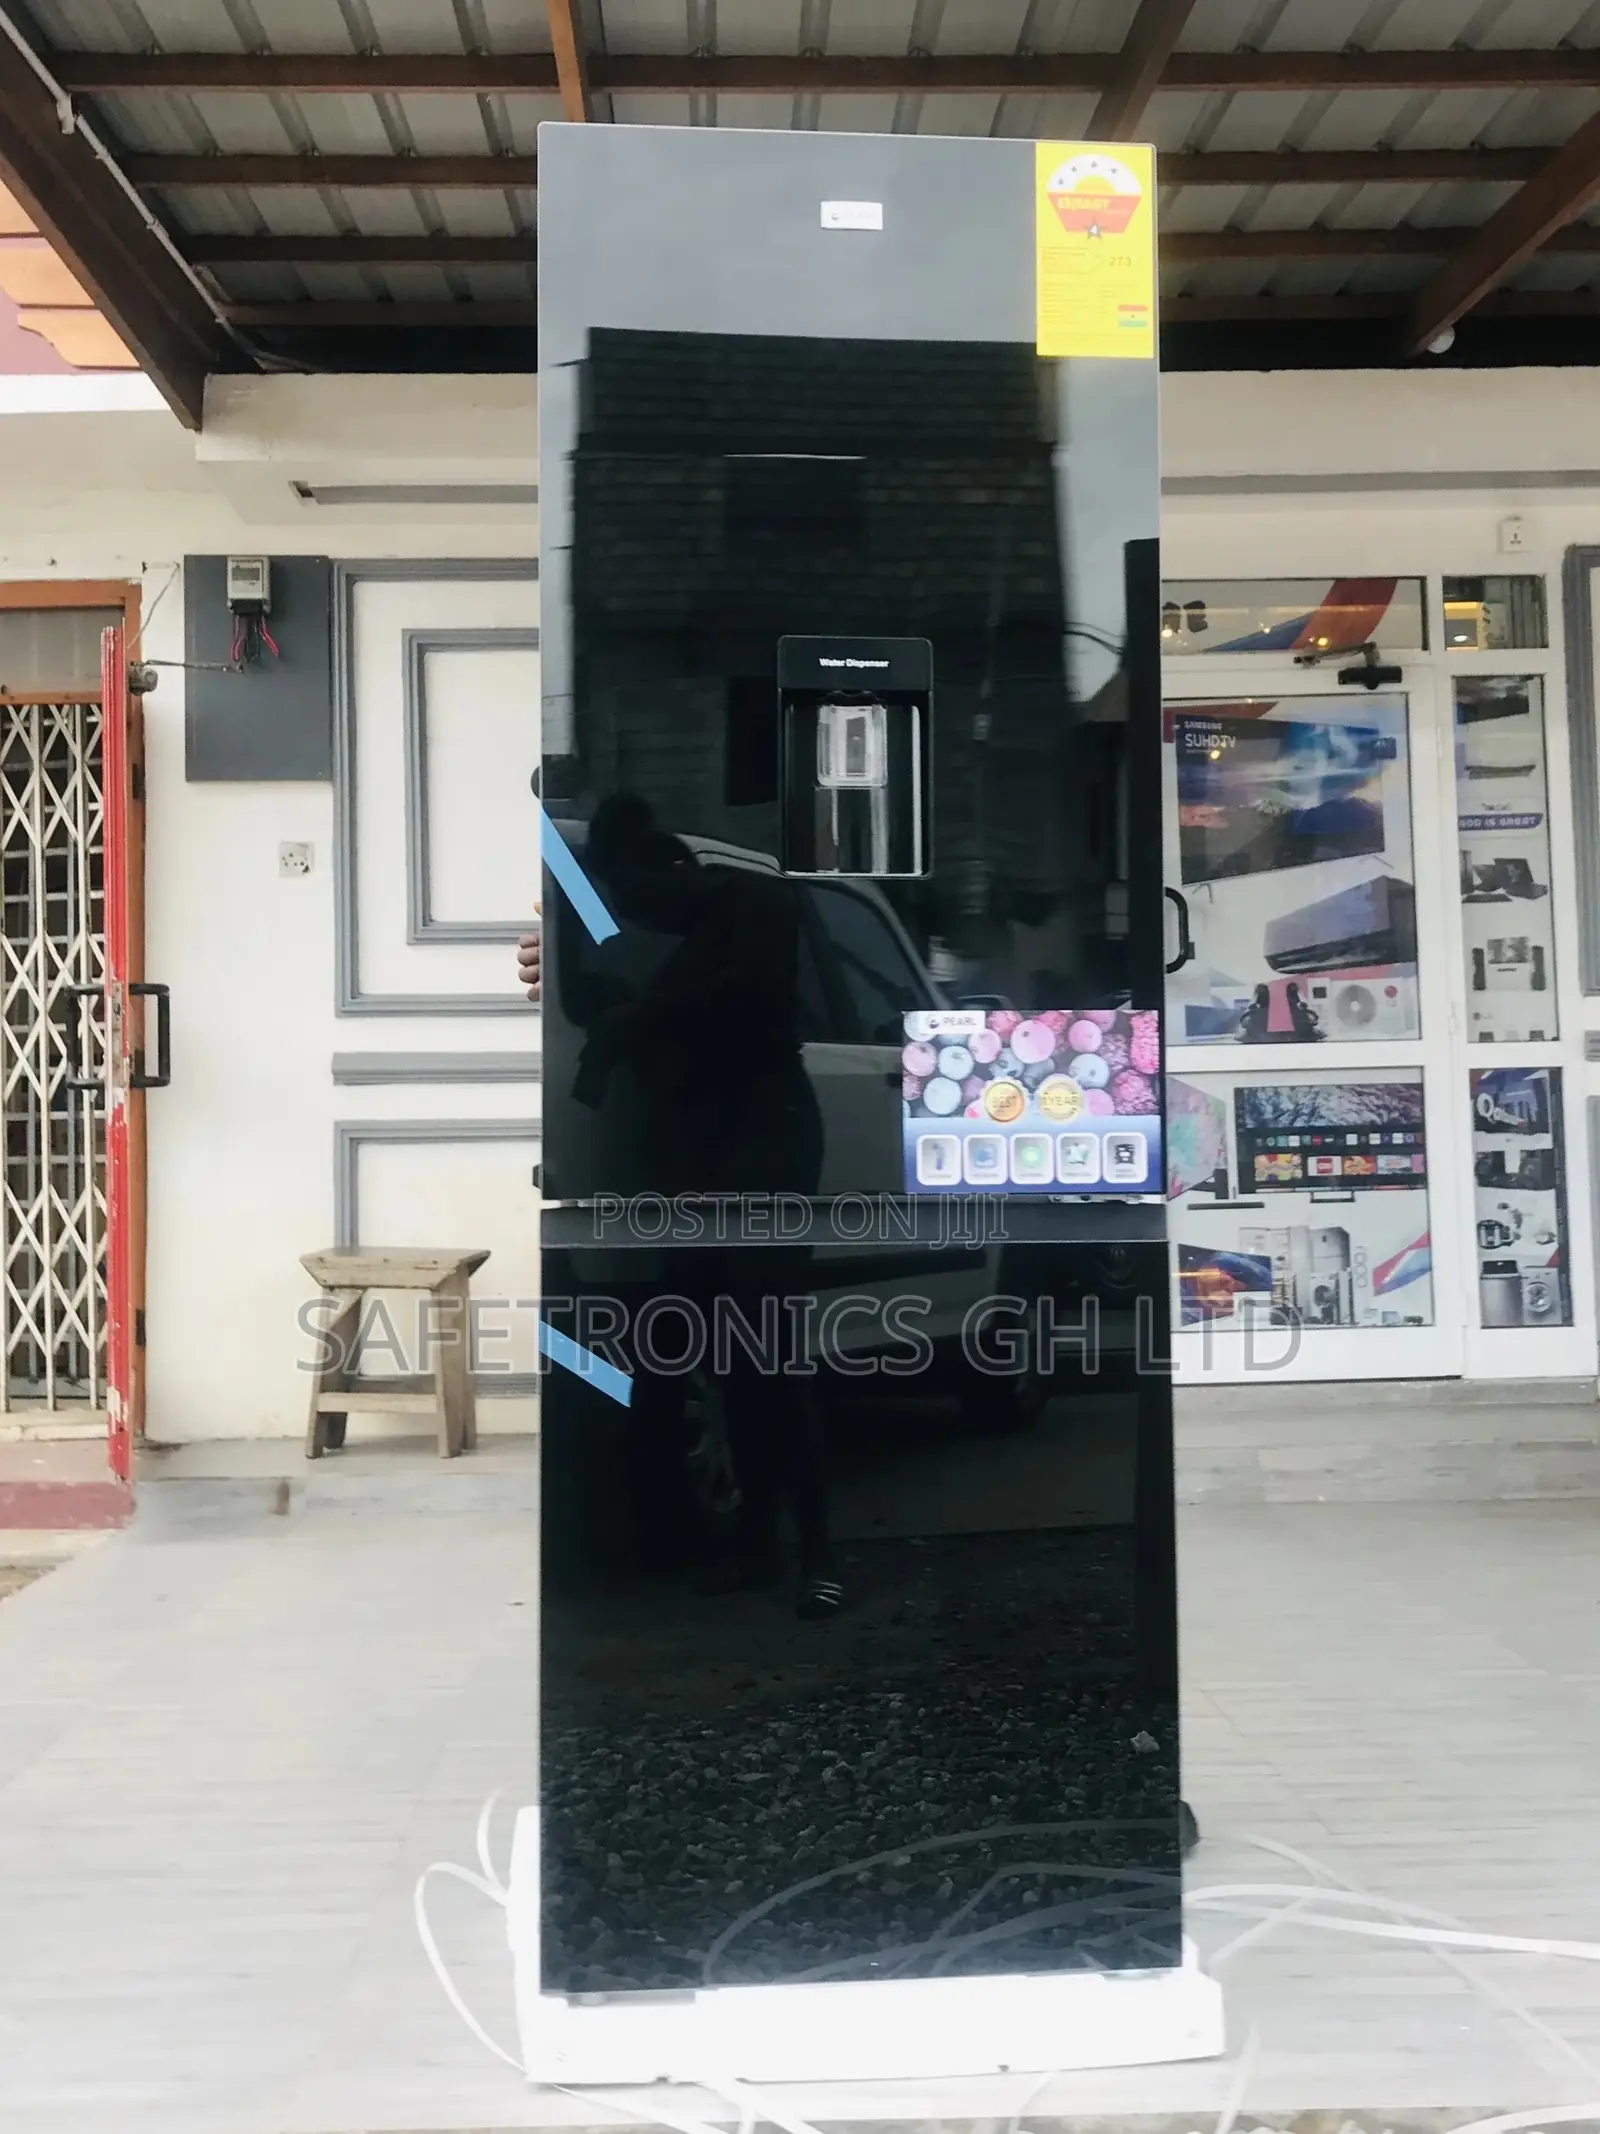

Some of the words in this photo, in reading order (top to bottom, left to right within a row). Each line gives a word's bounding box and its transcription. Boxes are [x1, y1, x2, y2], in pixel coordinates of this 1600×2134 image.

[819, 658, 845, 667] Water
[846, 658, 889, 668] Dispenser
[1184, 733, 1237, 748] SUHDTV
